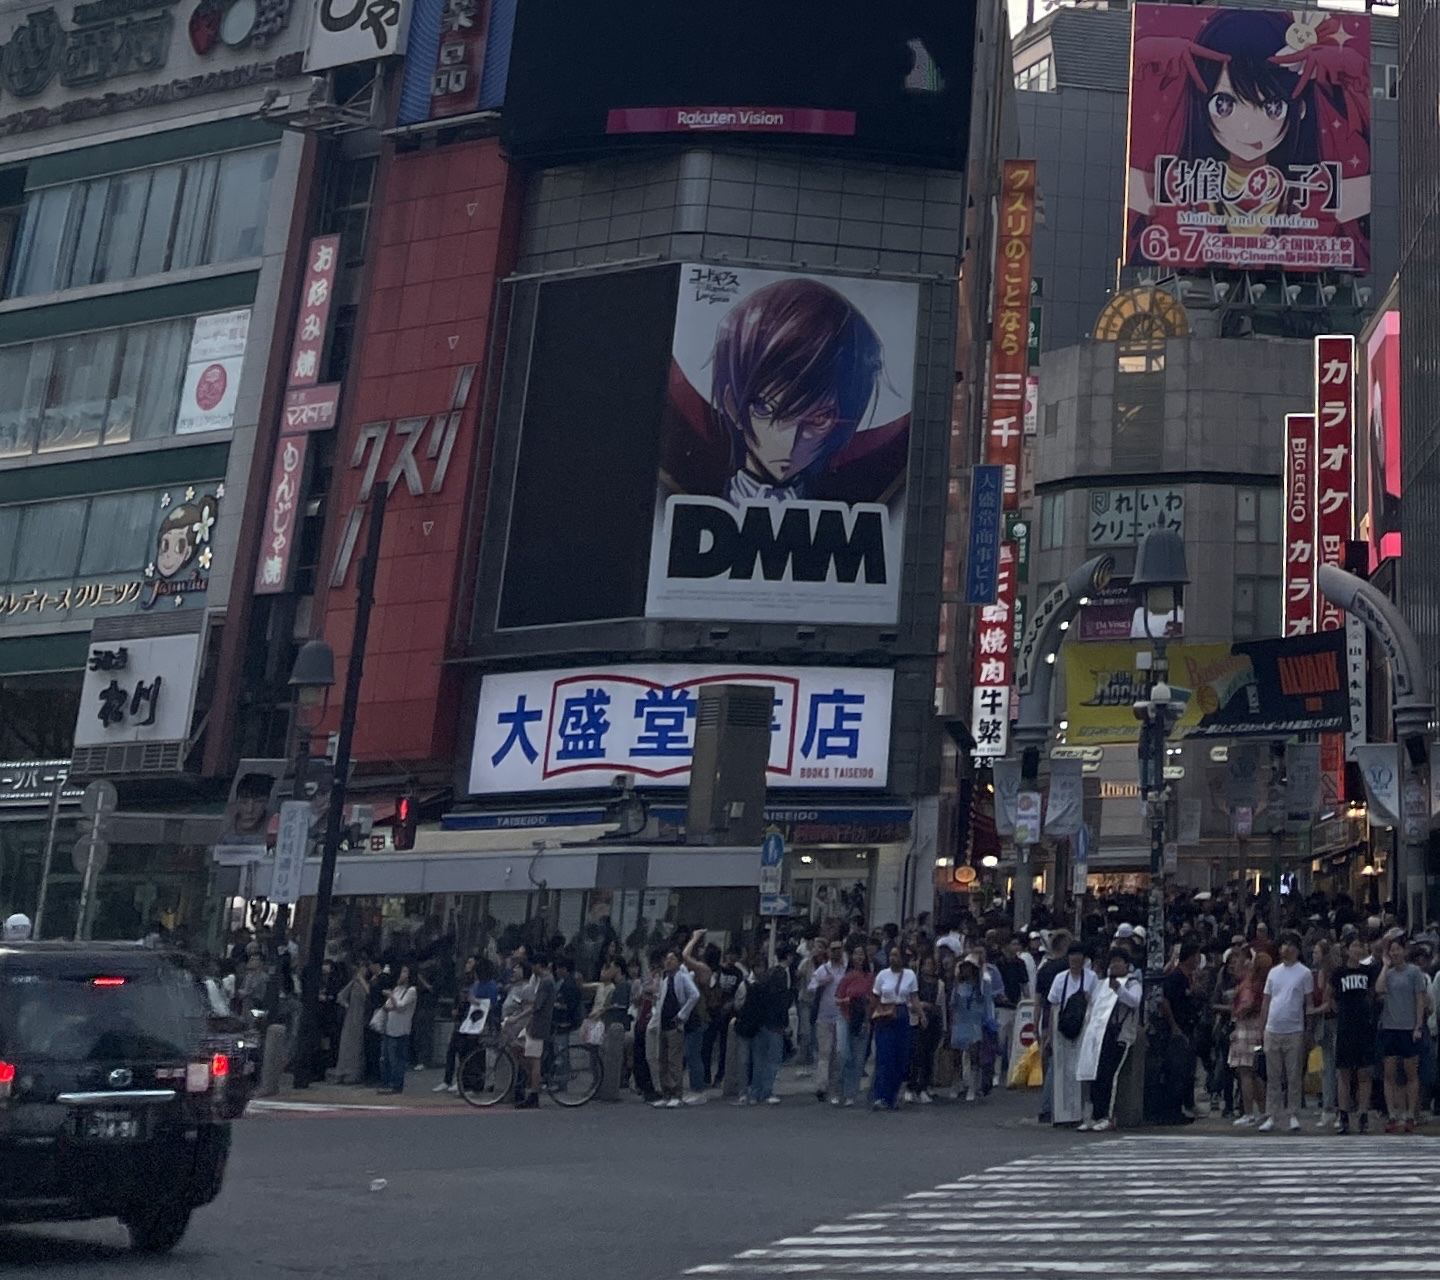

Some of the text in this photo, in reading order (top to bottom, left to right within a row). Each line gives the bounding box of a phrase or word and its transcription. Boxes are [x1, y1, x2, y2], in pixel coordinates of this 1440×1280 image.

[677, 110, 784, 127] Rakuten Vision
[1154, 154, 1342, 212] 【推しの子】
[1177, 210, 1318, 228] Mother and Children
[1000, 168, 1031, 357] クスリのことなら
[1141, 224, 1206, 261] 6.7
[350, 410, 463, 502] クスリ
[1320, 357, 1349, 516] カラオケ
[1114, 490, 1183, 515] れいわ
[1290, 438, 1307, 524] BIG ECHO
[667, 503, 888, 585] DMM
[1091, 518, 1182, 542] クリニック
[978, 544, 1014, 684] 輪焼肉
[491, 686, 866, 768] 大盛堂店
[978, 689, 1004, 744] 牛繁
[800, 767, 875, 779] BOOKS TAISEIDO
[497, 816, 548, 827] TAISEIDO
[762, 810, 819, 822] AISEIDO
[1341, 974, 1368, 992] NIKE
